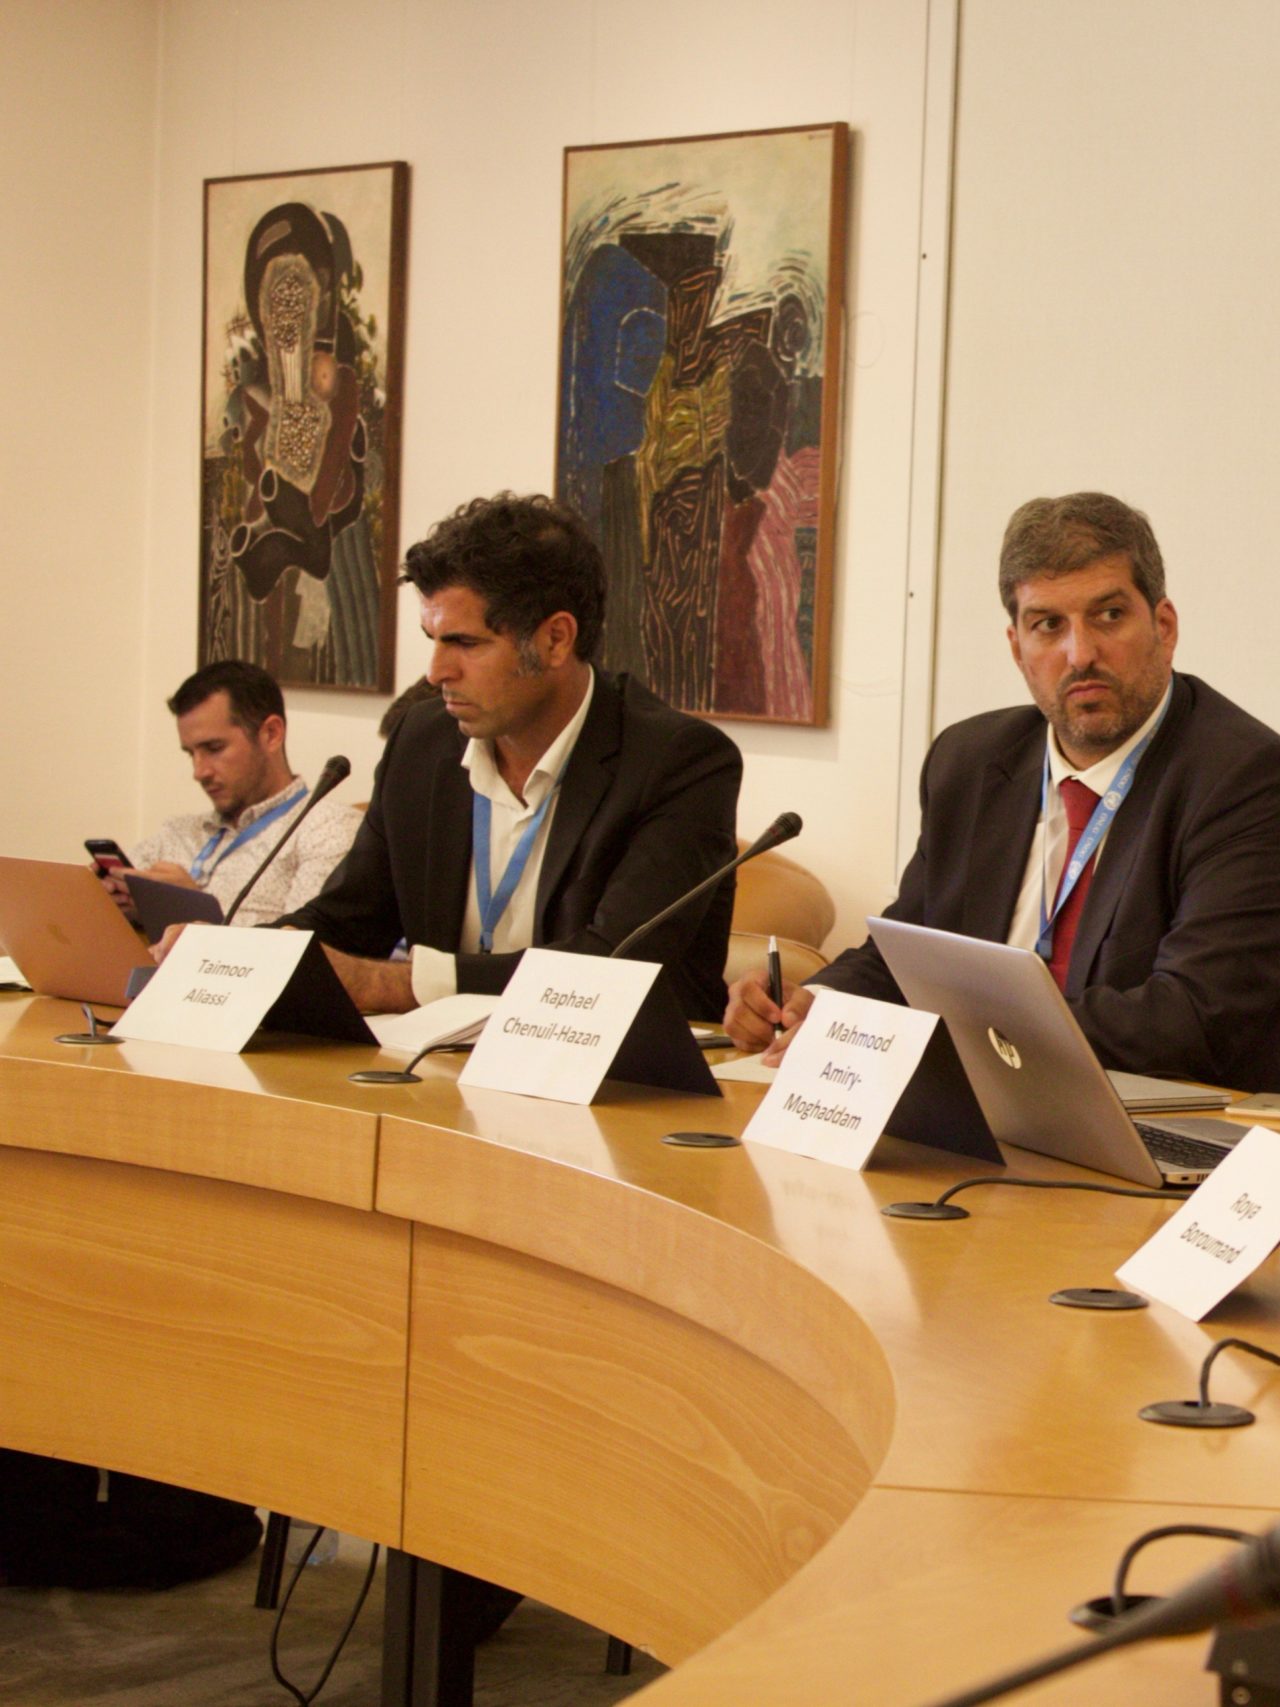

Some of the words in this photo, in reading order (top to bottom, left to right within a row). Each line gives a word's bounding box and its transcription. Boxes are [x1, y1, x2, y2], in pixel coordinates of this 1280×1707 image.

[198, 957, 255, 979] Taimoor
[183, 988, 229, 1007] Aliassi
[540, 986, 601, 1012] Raphael
[503, 1016, 602, 1047] Chenuil-Hazan
[826, 1020, 896, 1053] Mahmood
[819, 1060, 863, 1091] Amiry-
[782, 1092, 863, 1131] Moghaddam
[1230, 1192, 1263, 1222] Roya
[1180, 1221, 1246, 1265] Boroumand
